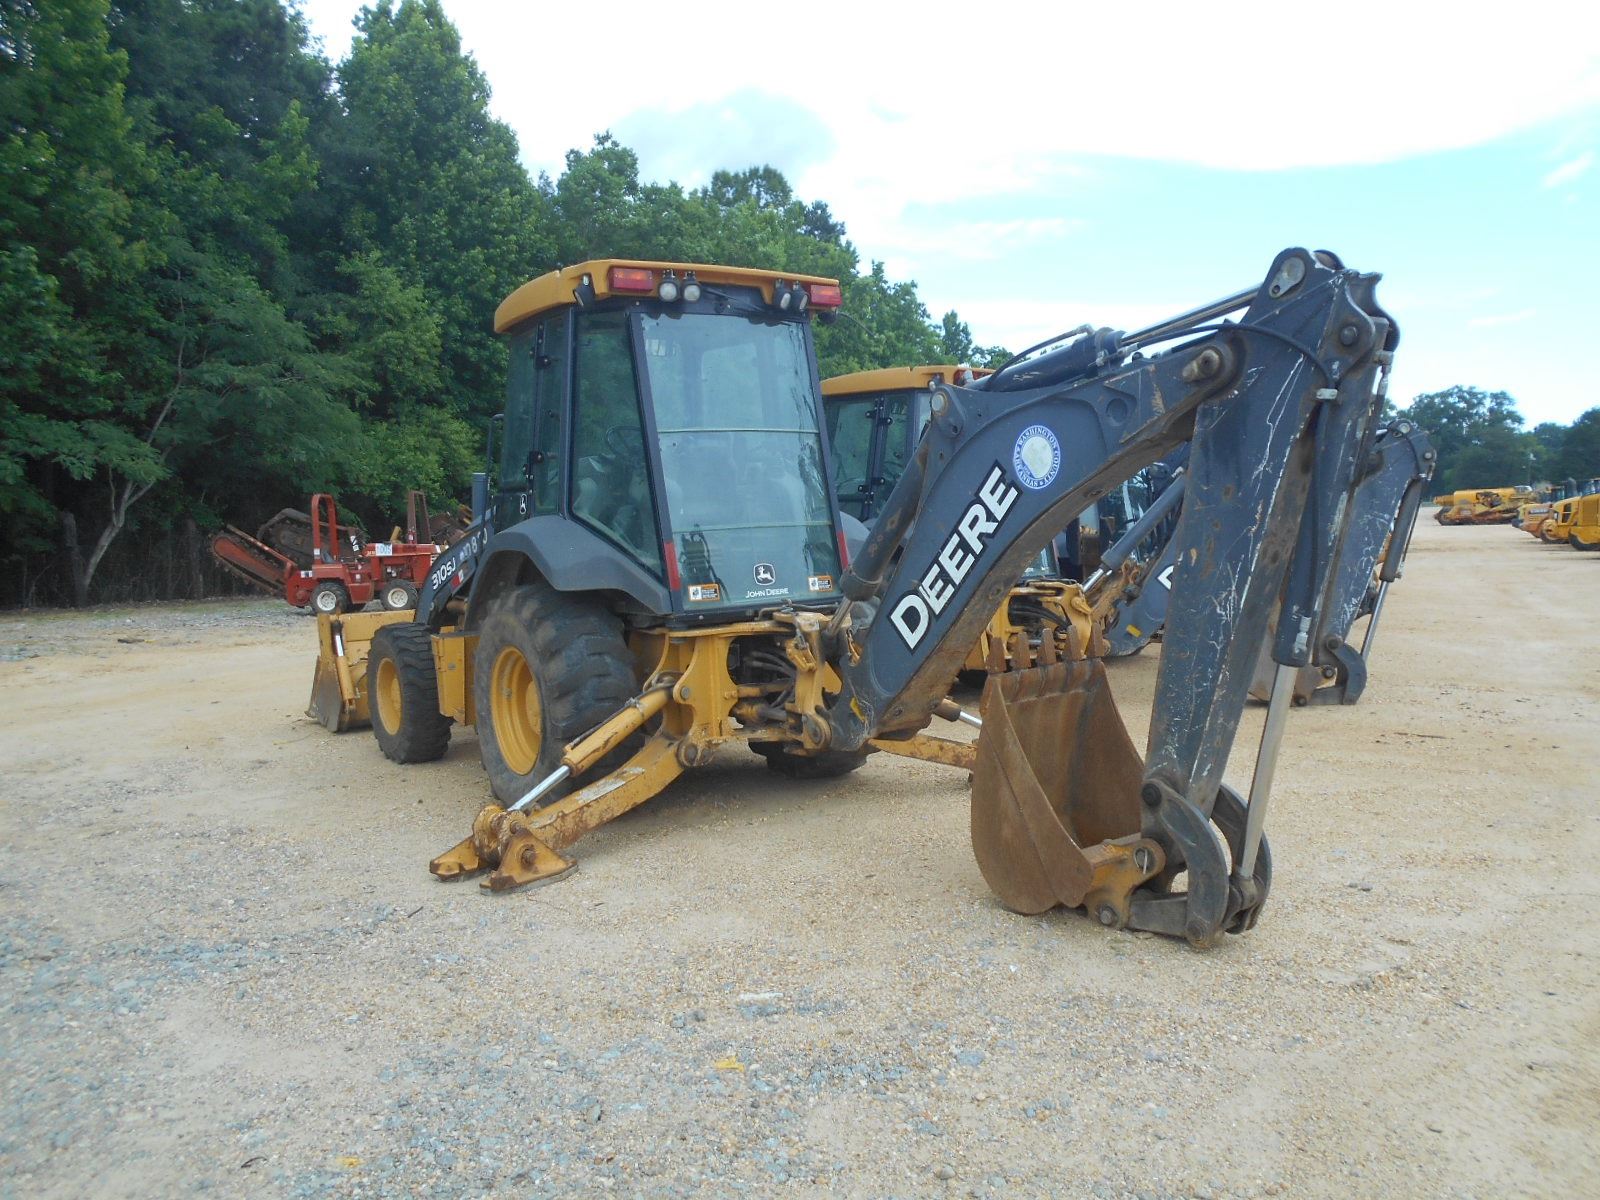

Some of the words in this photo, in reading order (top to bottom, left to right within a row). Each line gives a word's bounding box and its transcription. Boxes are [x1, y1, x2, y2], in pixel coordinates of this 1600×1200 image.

[1018, 426, 1057, 449] WASHINGTON
[890, 466, 1018, 650] DEERE
[431, 557, 456, 590] 310SJ
[745, 589, 766, 599] JOHN
[766, 587, 789, 597] DEERE
